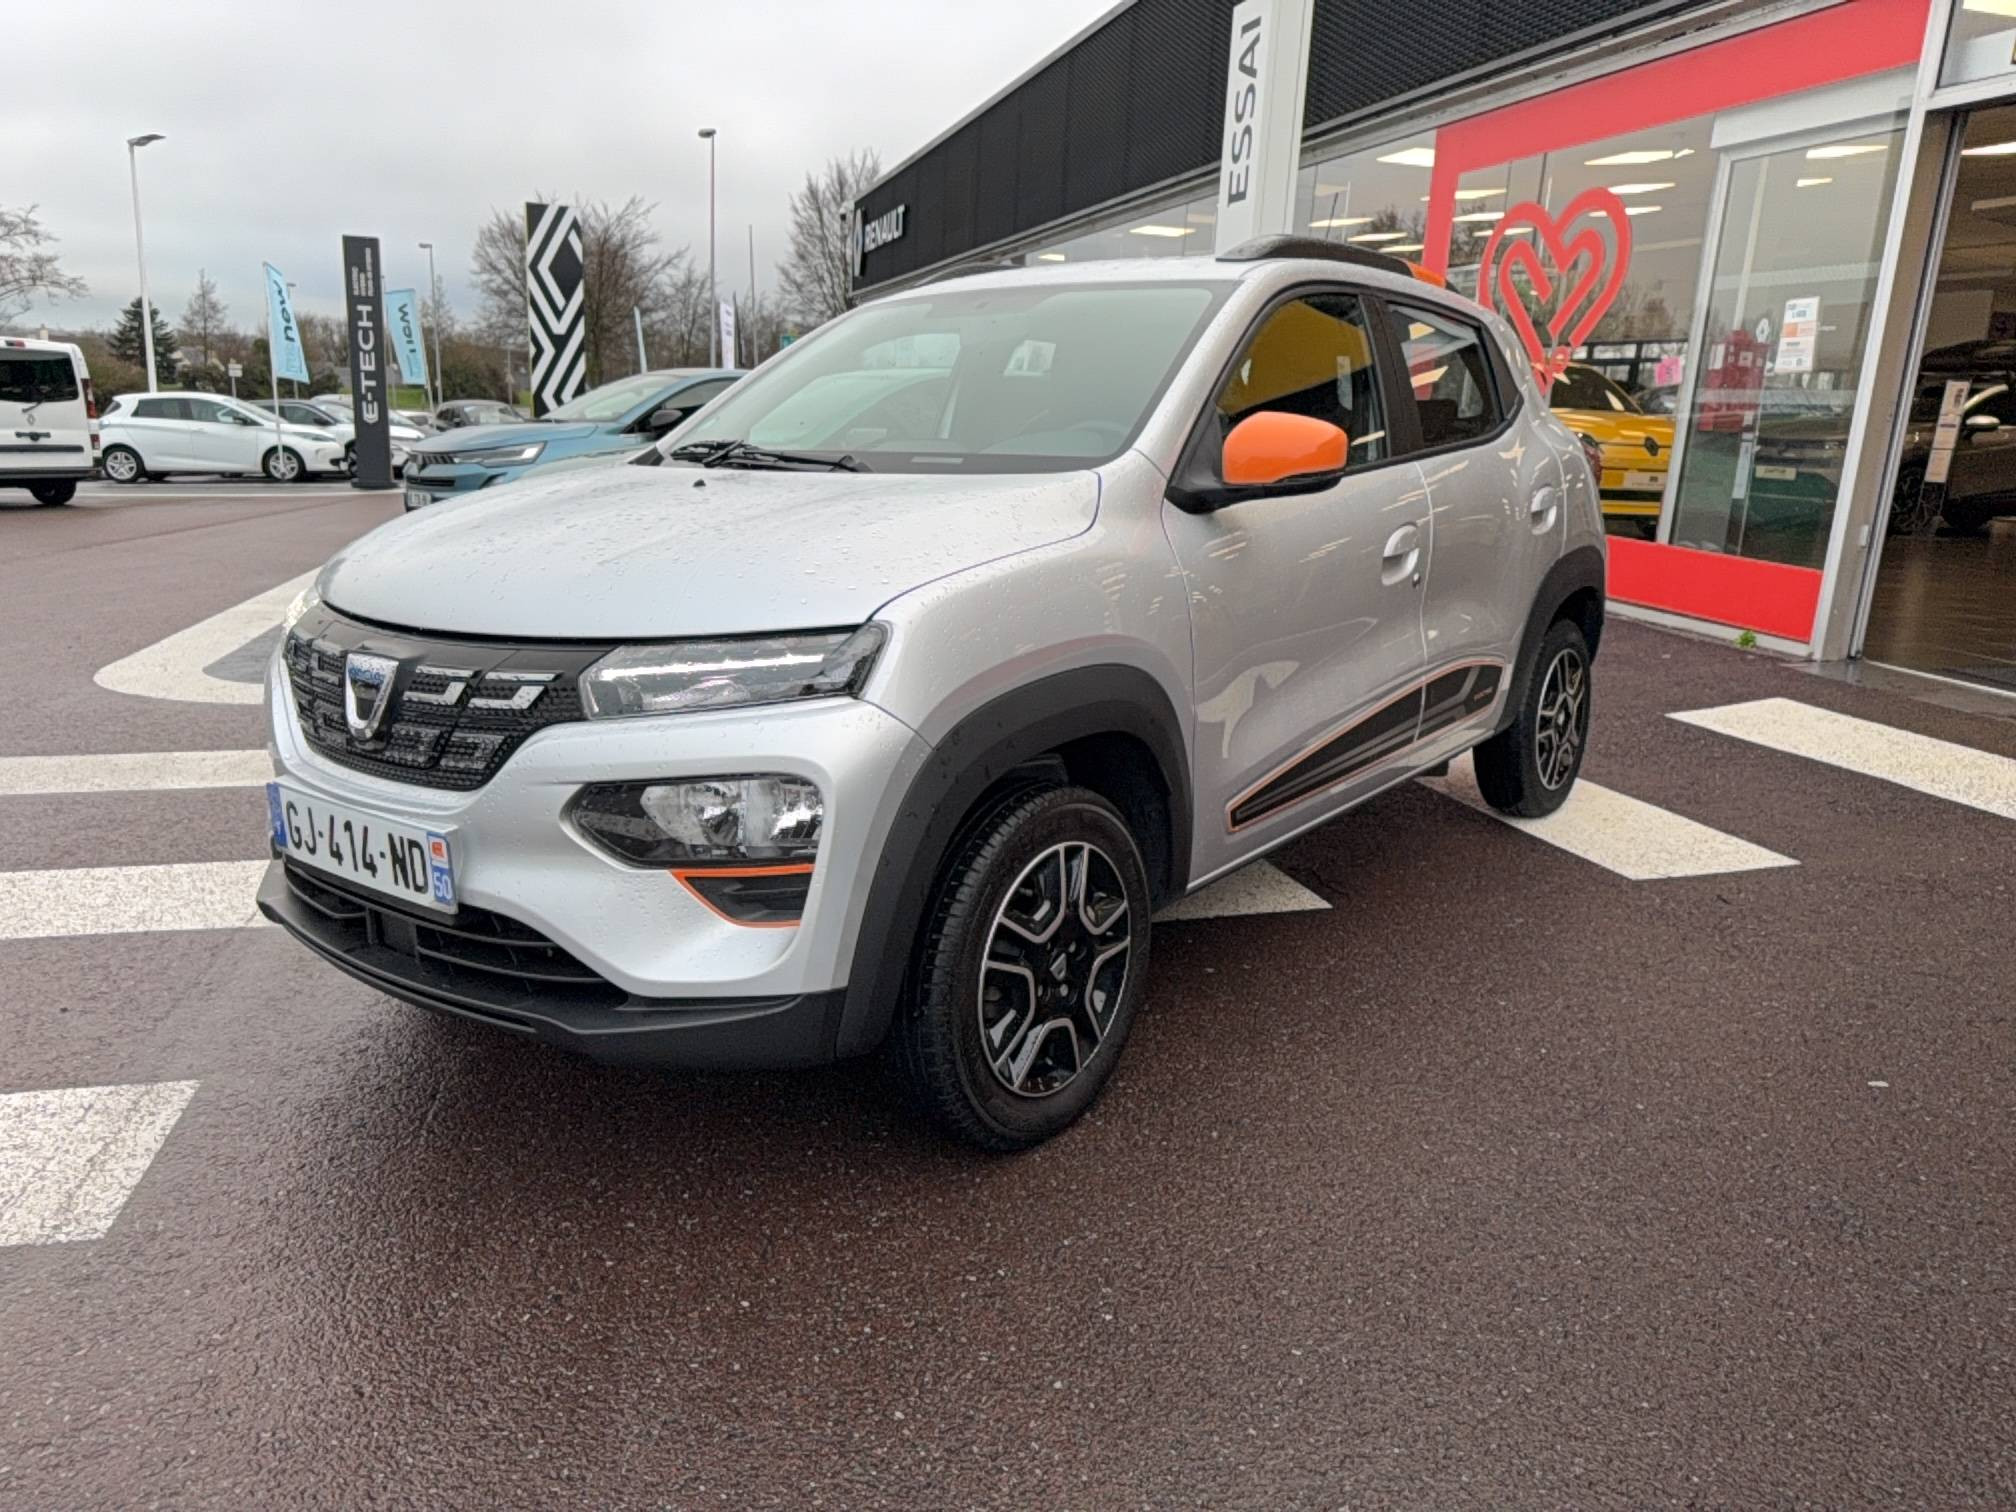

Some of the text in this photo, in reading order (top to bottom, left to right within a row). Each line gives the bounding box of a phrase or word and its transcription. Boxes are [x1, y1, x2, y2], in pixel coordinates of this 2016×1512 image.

[1228, 16, 1262, 207] ESSAI
[864, 204, 905, 252] RENAULT
[357, 304, 379, 423] E-TECH
[286, 800, 429, 894] GJ-414-ND
[433, 871, 453, 899] 50
